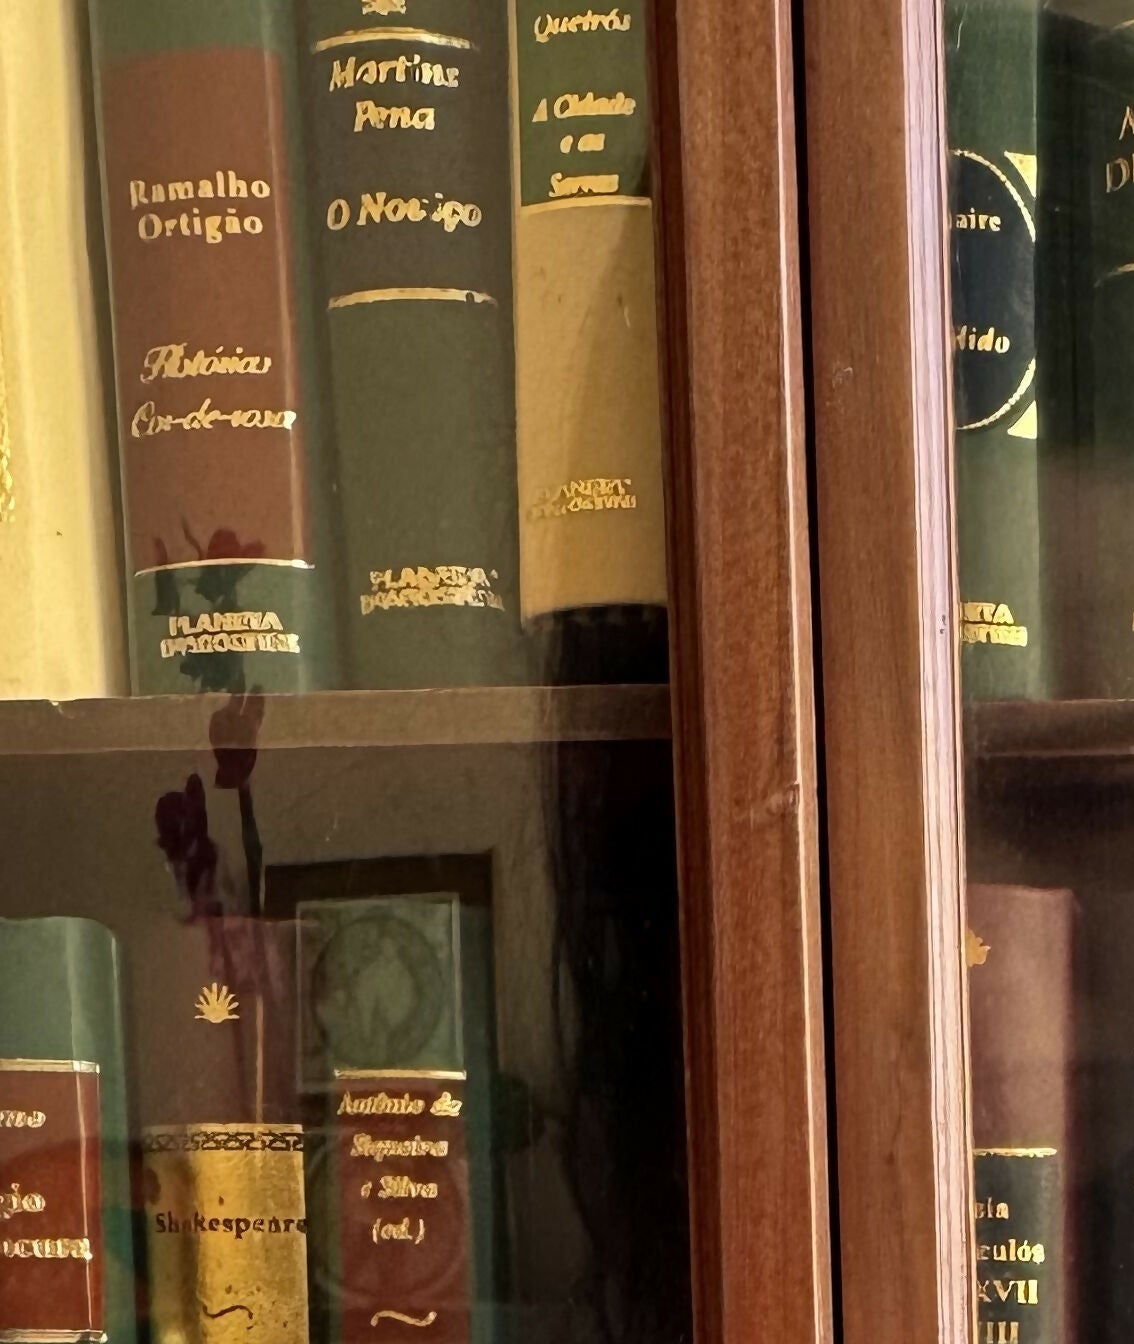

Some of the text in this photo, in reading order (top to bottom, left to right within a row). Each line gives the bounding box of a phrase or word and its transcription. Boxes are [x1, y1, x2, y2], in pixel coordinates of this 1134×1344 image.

[129, 170, 271, 210] Ramalho
[138, 207, 264, 244] Ortigão
[326, 198, 351, 231] O
[155, 1211, 309, 1240] Shakespeare
